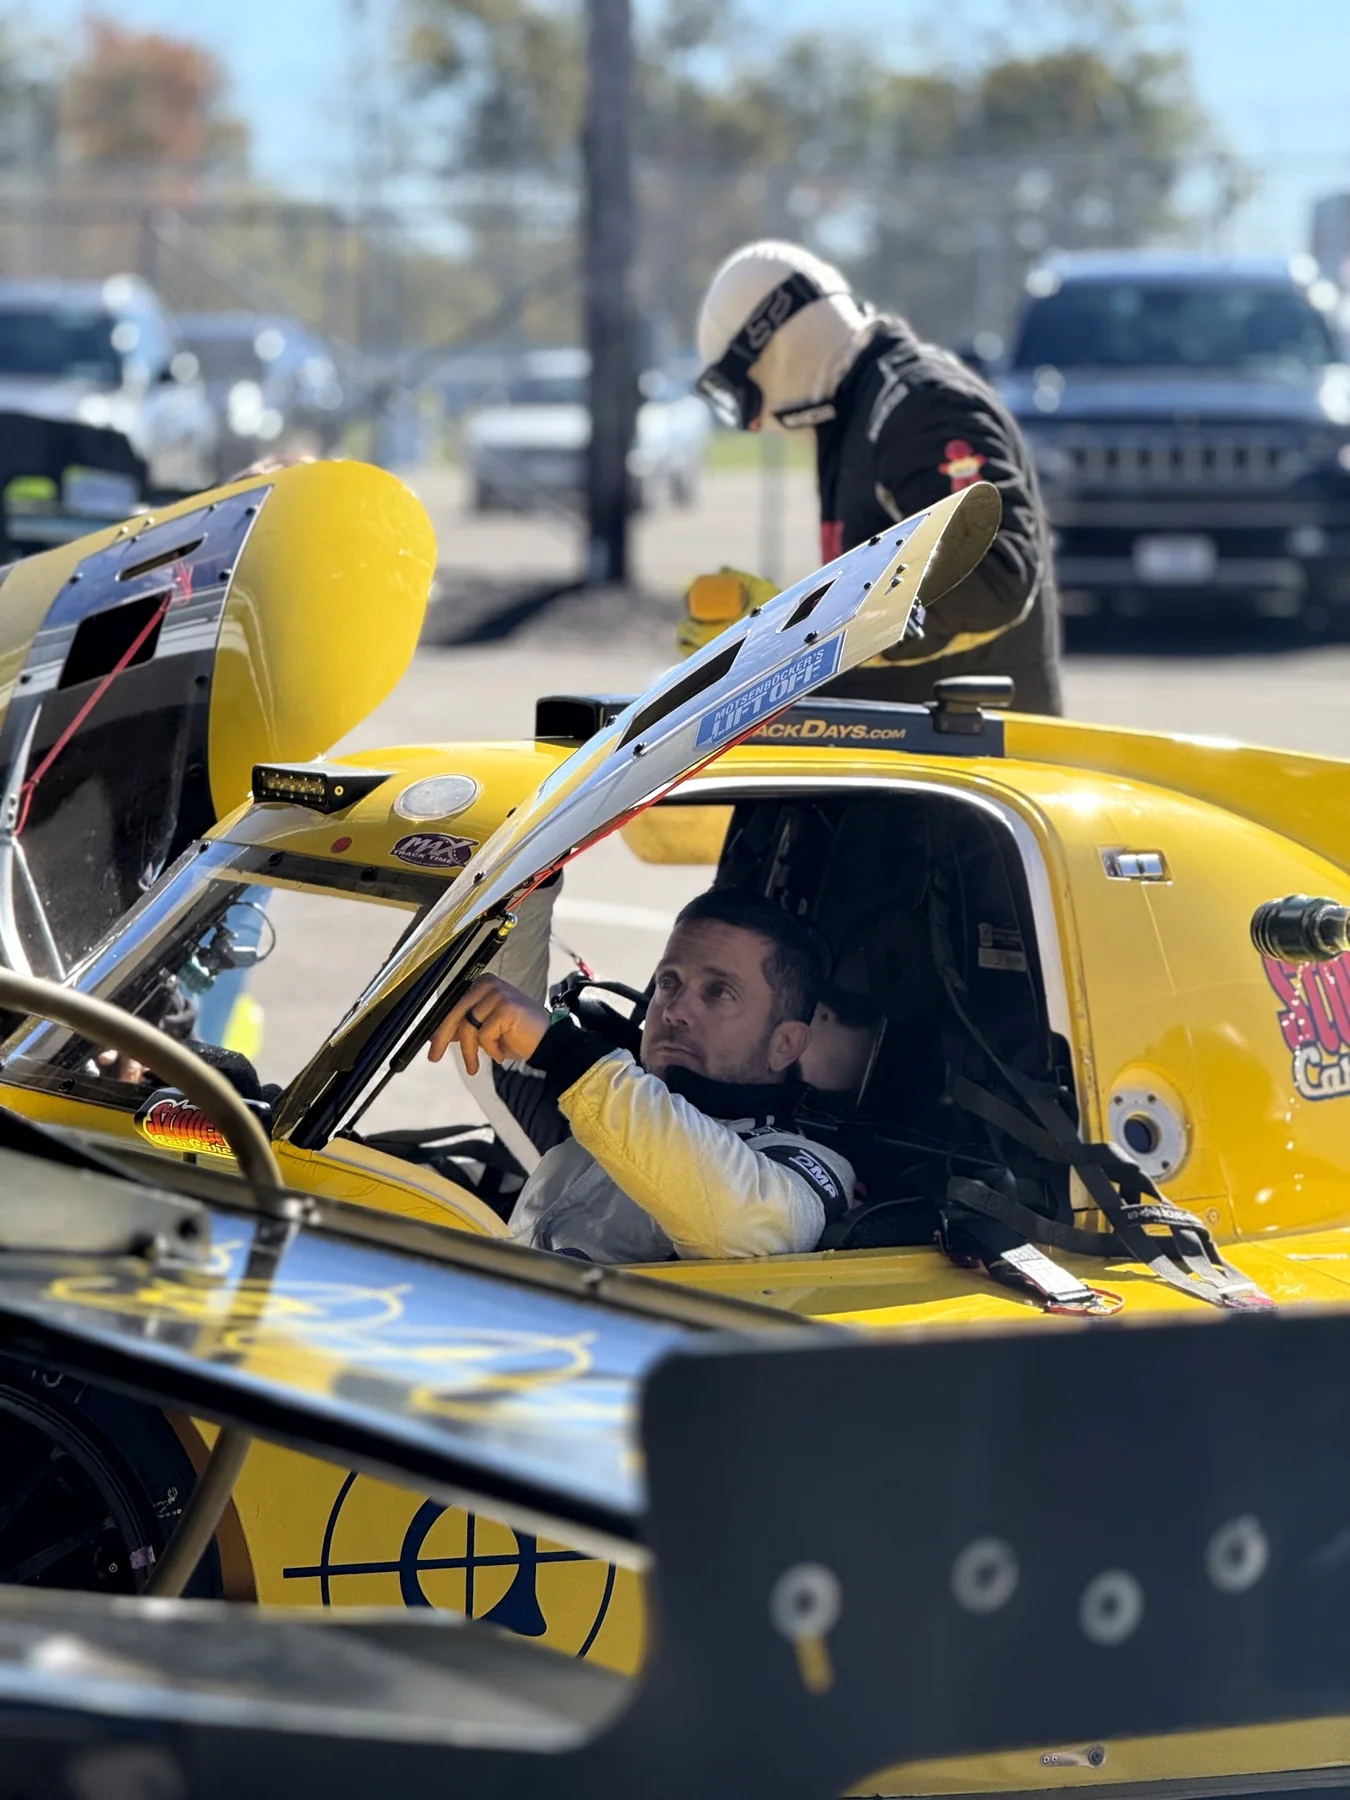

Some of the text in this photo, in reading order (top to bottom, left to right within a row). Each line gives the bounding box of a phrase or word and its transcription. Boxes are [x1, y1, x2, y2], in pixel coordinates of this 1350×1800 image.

[711, 658, 823, 739] LIFT OFF
[713, 648, 825, 721] MÖTSENBÖCKER'S
[393, 849, 426, 860] TRACK
[429, 855, 453, 864] TIME
[400, 836, 474, 861] MAX
[793, 1155, 837, 1198] OMP
